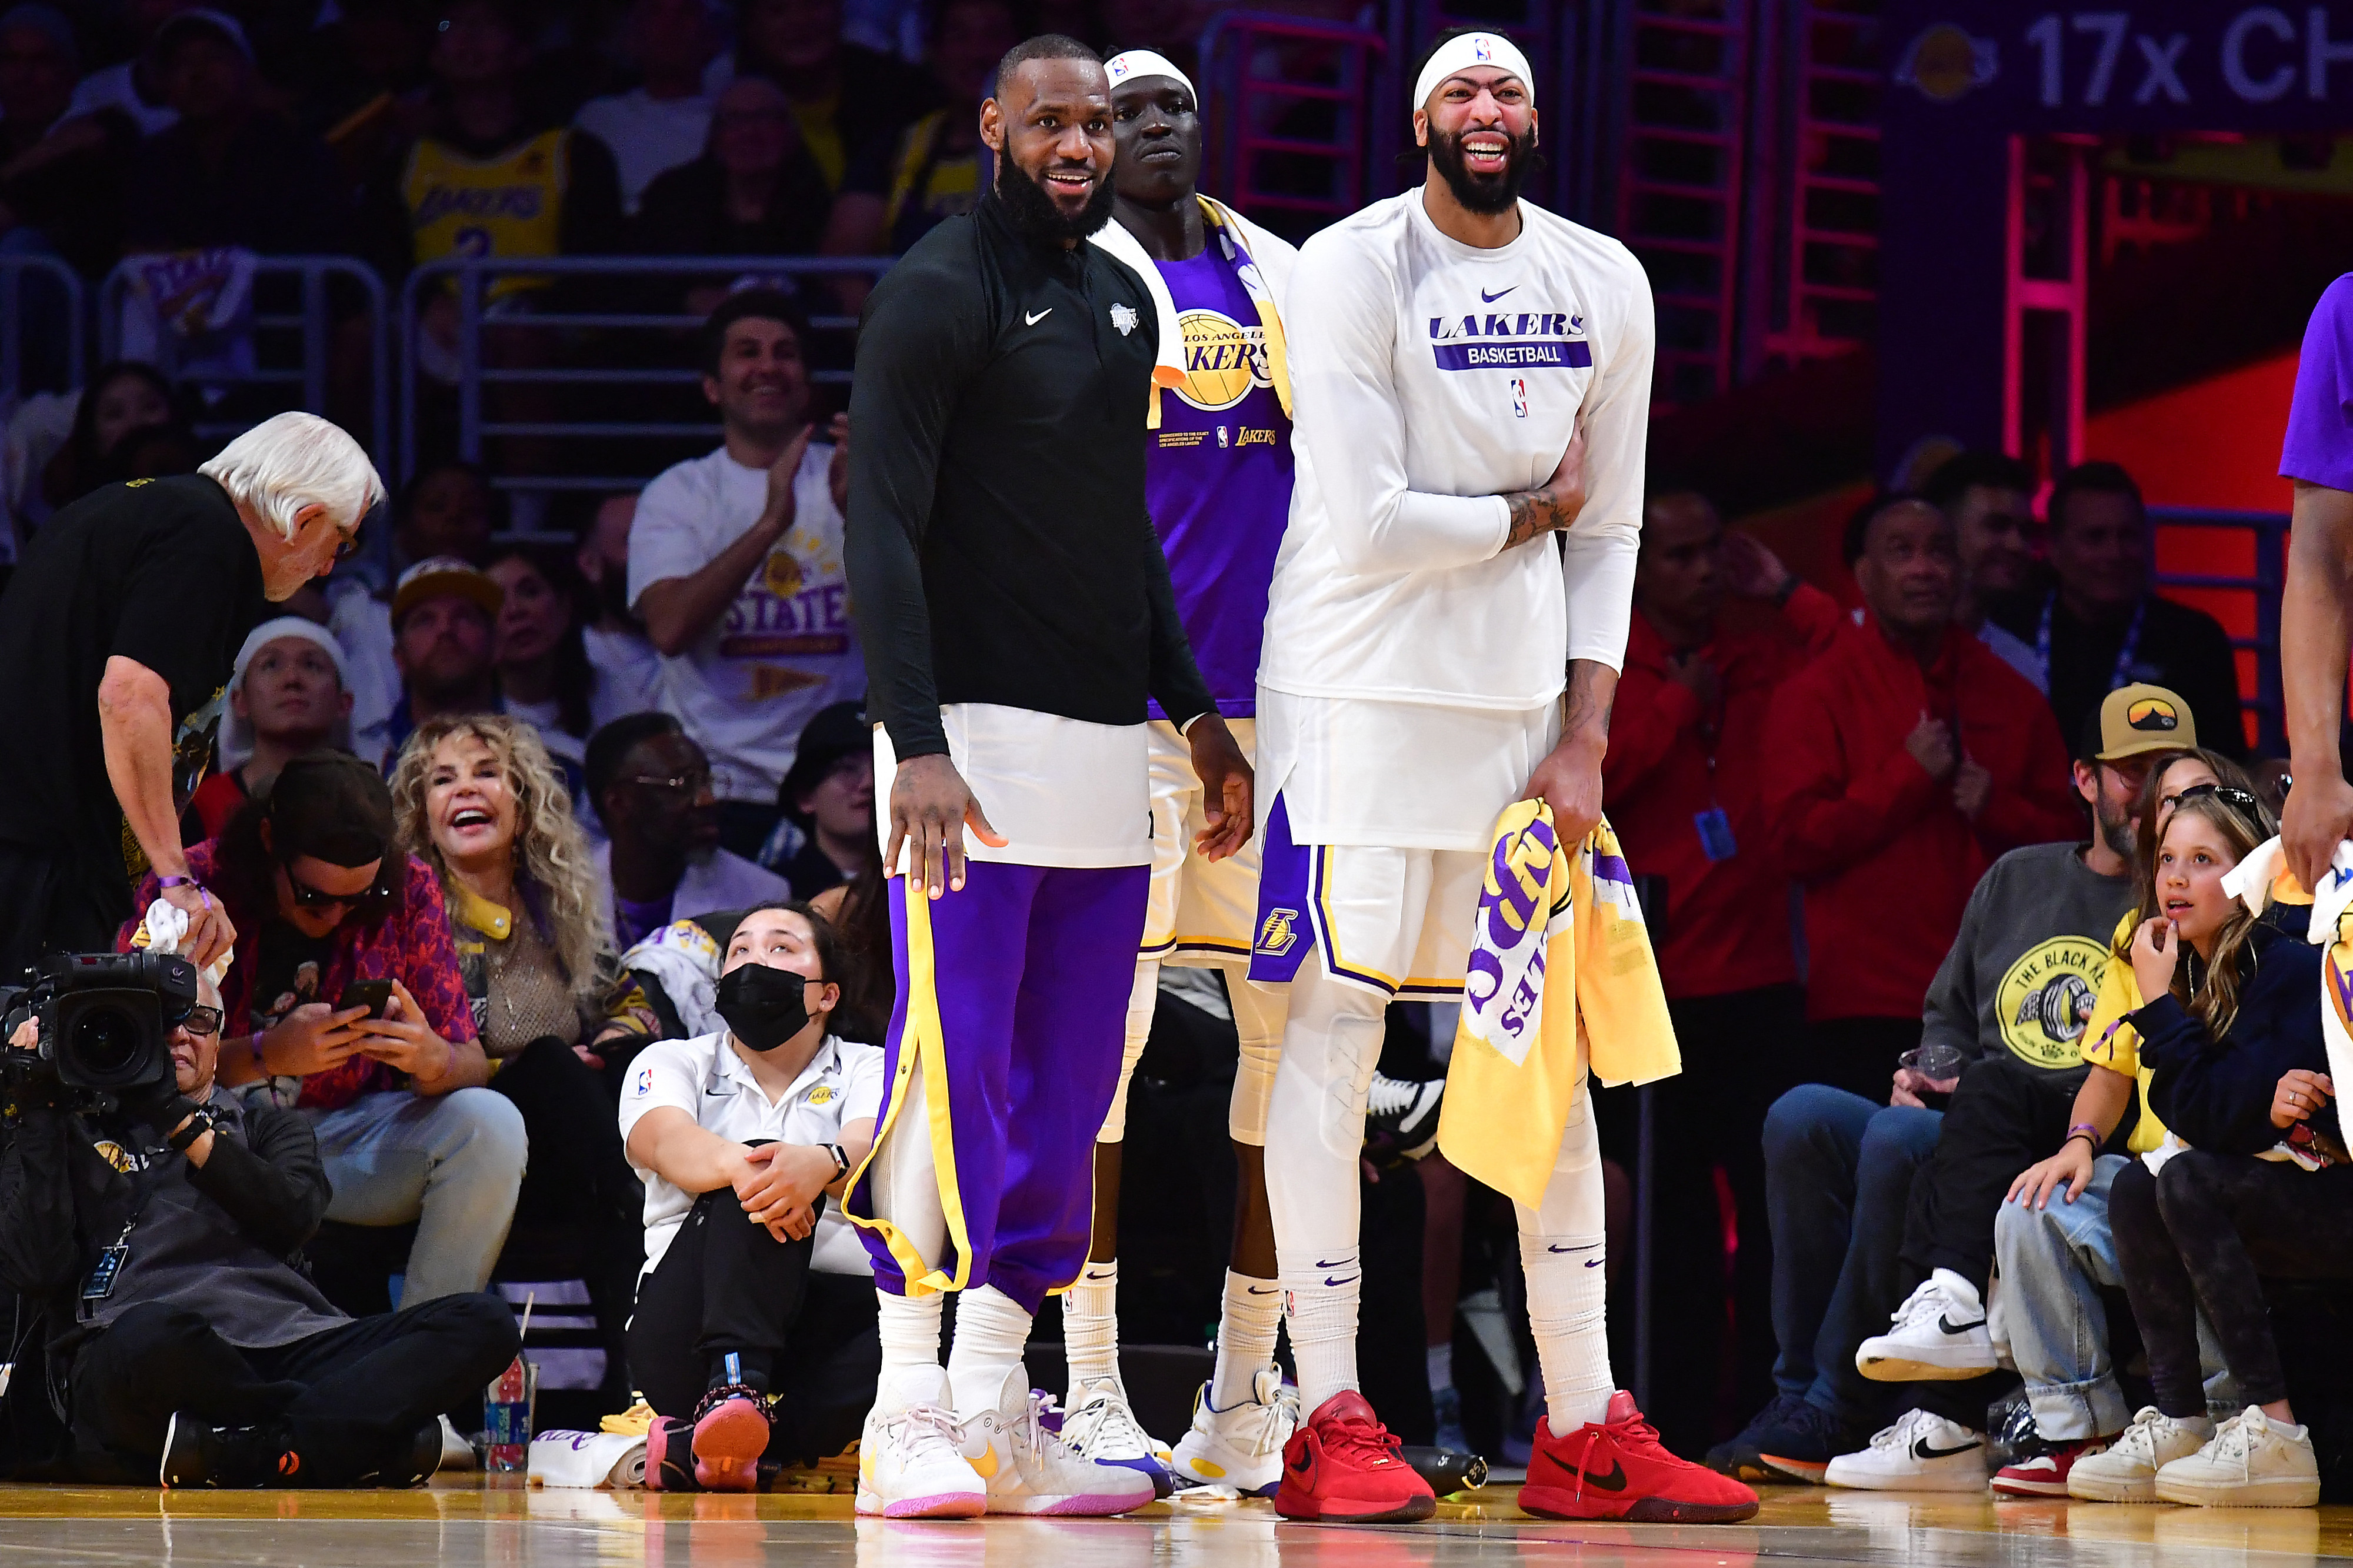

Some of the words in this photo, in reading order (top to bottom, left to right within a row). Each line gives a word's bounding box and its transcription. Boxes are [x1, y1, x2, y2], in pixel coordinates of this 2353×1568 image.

[2023, 9, 2192, 108] 17x
[1184, 333, 1208, 342] LOS
[1212, 331, 1266, 341] ANGELE
[1428, 313, 1584, 339] LAKERS
[1468, 346, 1561, 364] BASKETBALL
[1235, 426, 1276, 446] LAKERS
[2015, 962, 2041, 989] THE
[2045, 950, 2091, 970] BLACK
